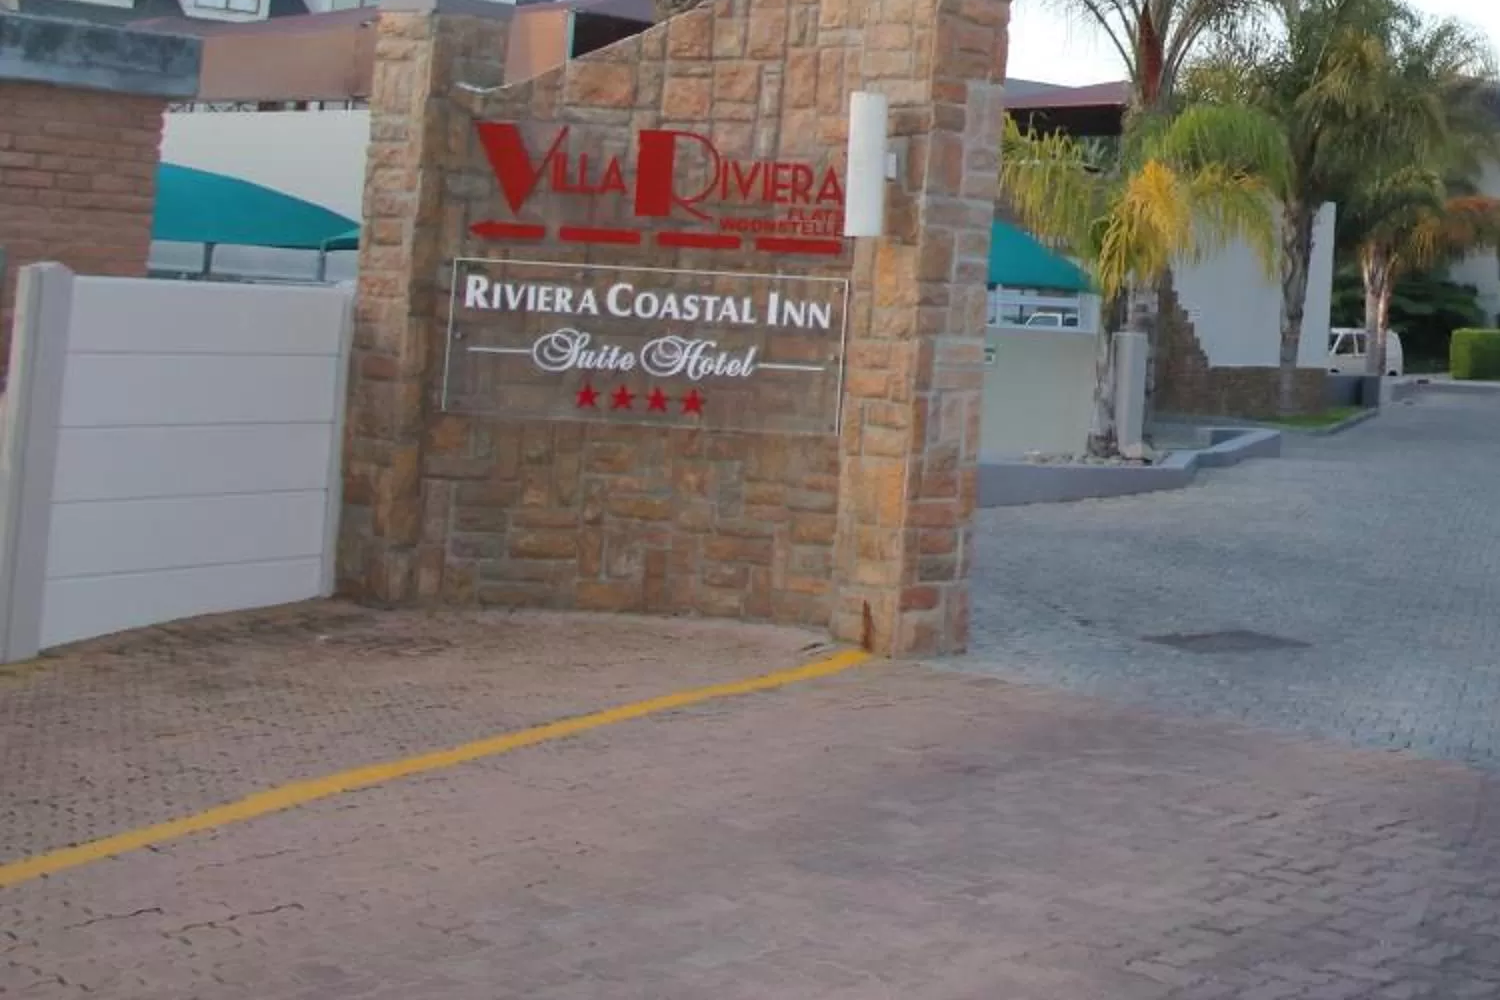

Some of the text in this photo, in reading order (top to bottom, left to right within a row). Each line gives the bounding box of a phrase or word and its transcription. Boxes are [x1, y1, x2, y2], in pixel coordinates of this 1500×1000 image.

[474, 121, 845, 222] VILLA RIVIERA
[464, 275, 832, 330] RIVIERA COASTAL INN
[532, 326, 760, 380] Suite Hotel
